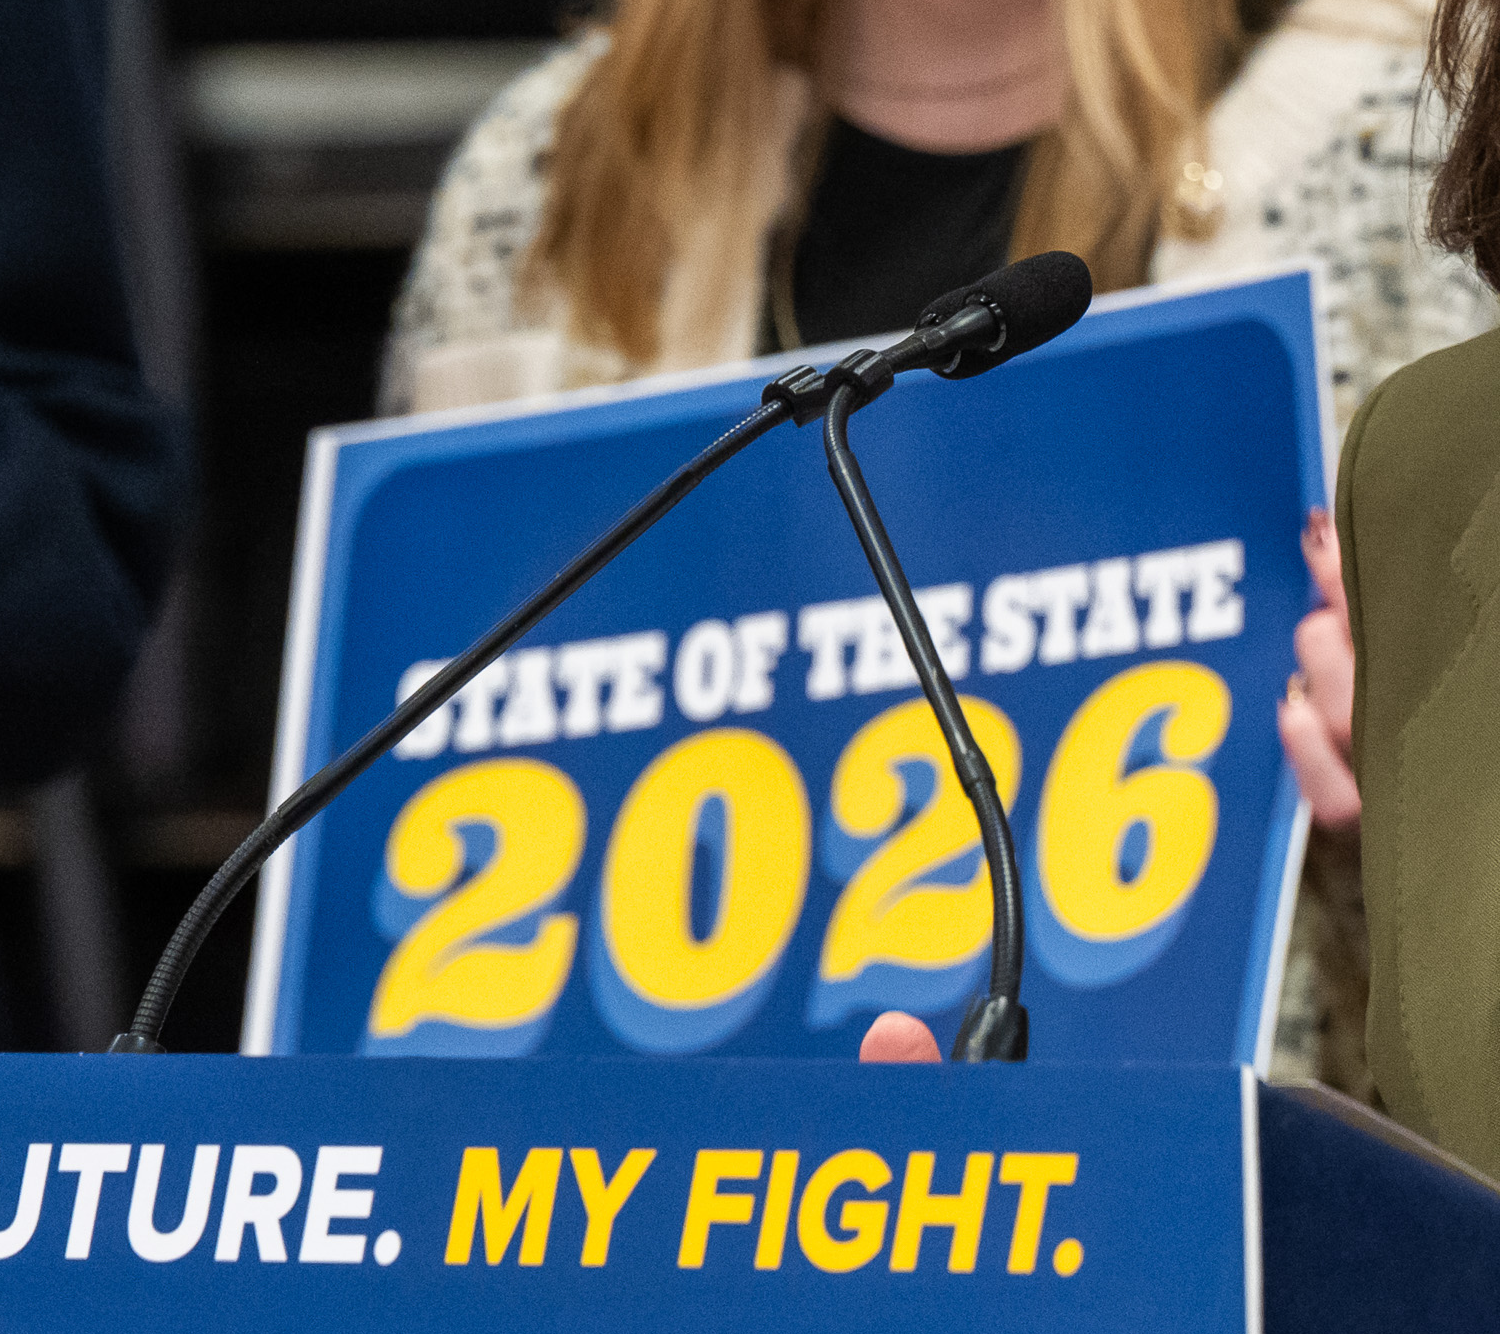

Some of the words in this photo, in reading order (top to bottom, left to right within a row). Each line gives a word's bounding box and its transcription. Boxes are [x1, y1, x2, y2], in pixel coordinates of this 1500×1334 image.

[674, 610, 788, 721] OF
[798, 583, 973, 701] THE
[981, 538, 1244, 674] STATE
[369, 659, 1233, 1038] 2026
[444, 1147, 657, 1266] MY
[676, 1148, 1084, 1277] FIGHT.
